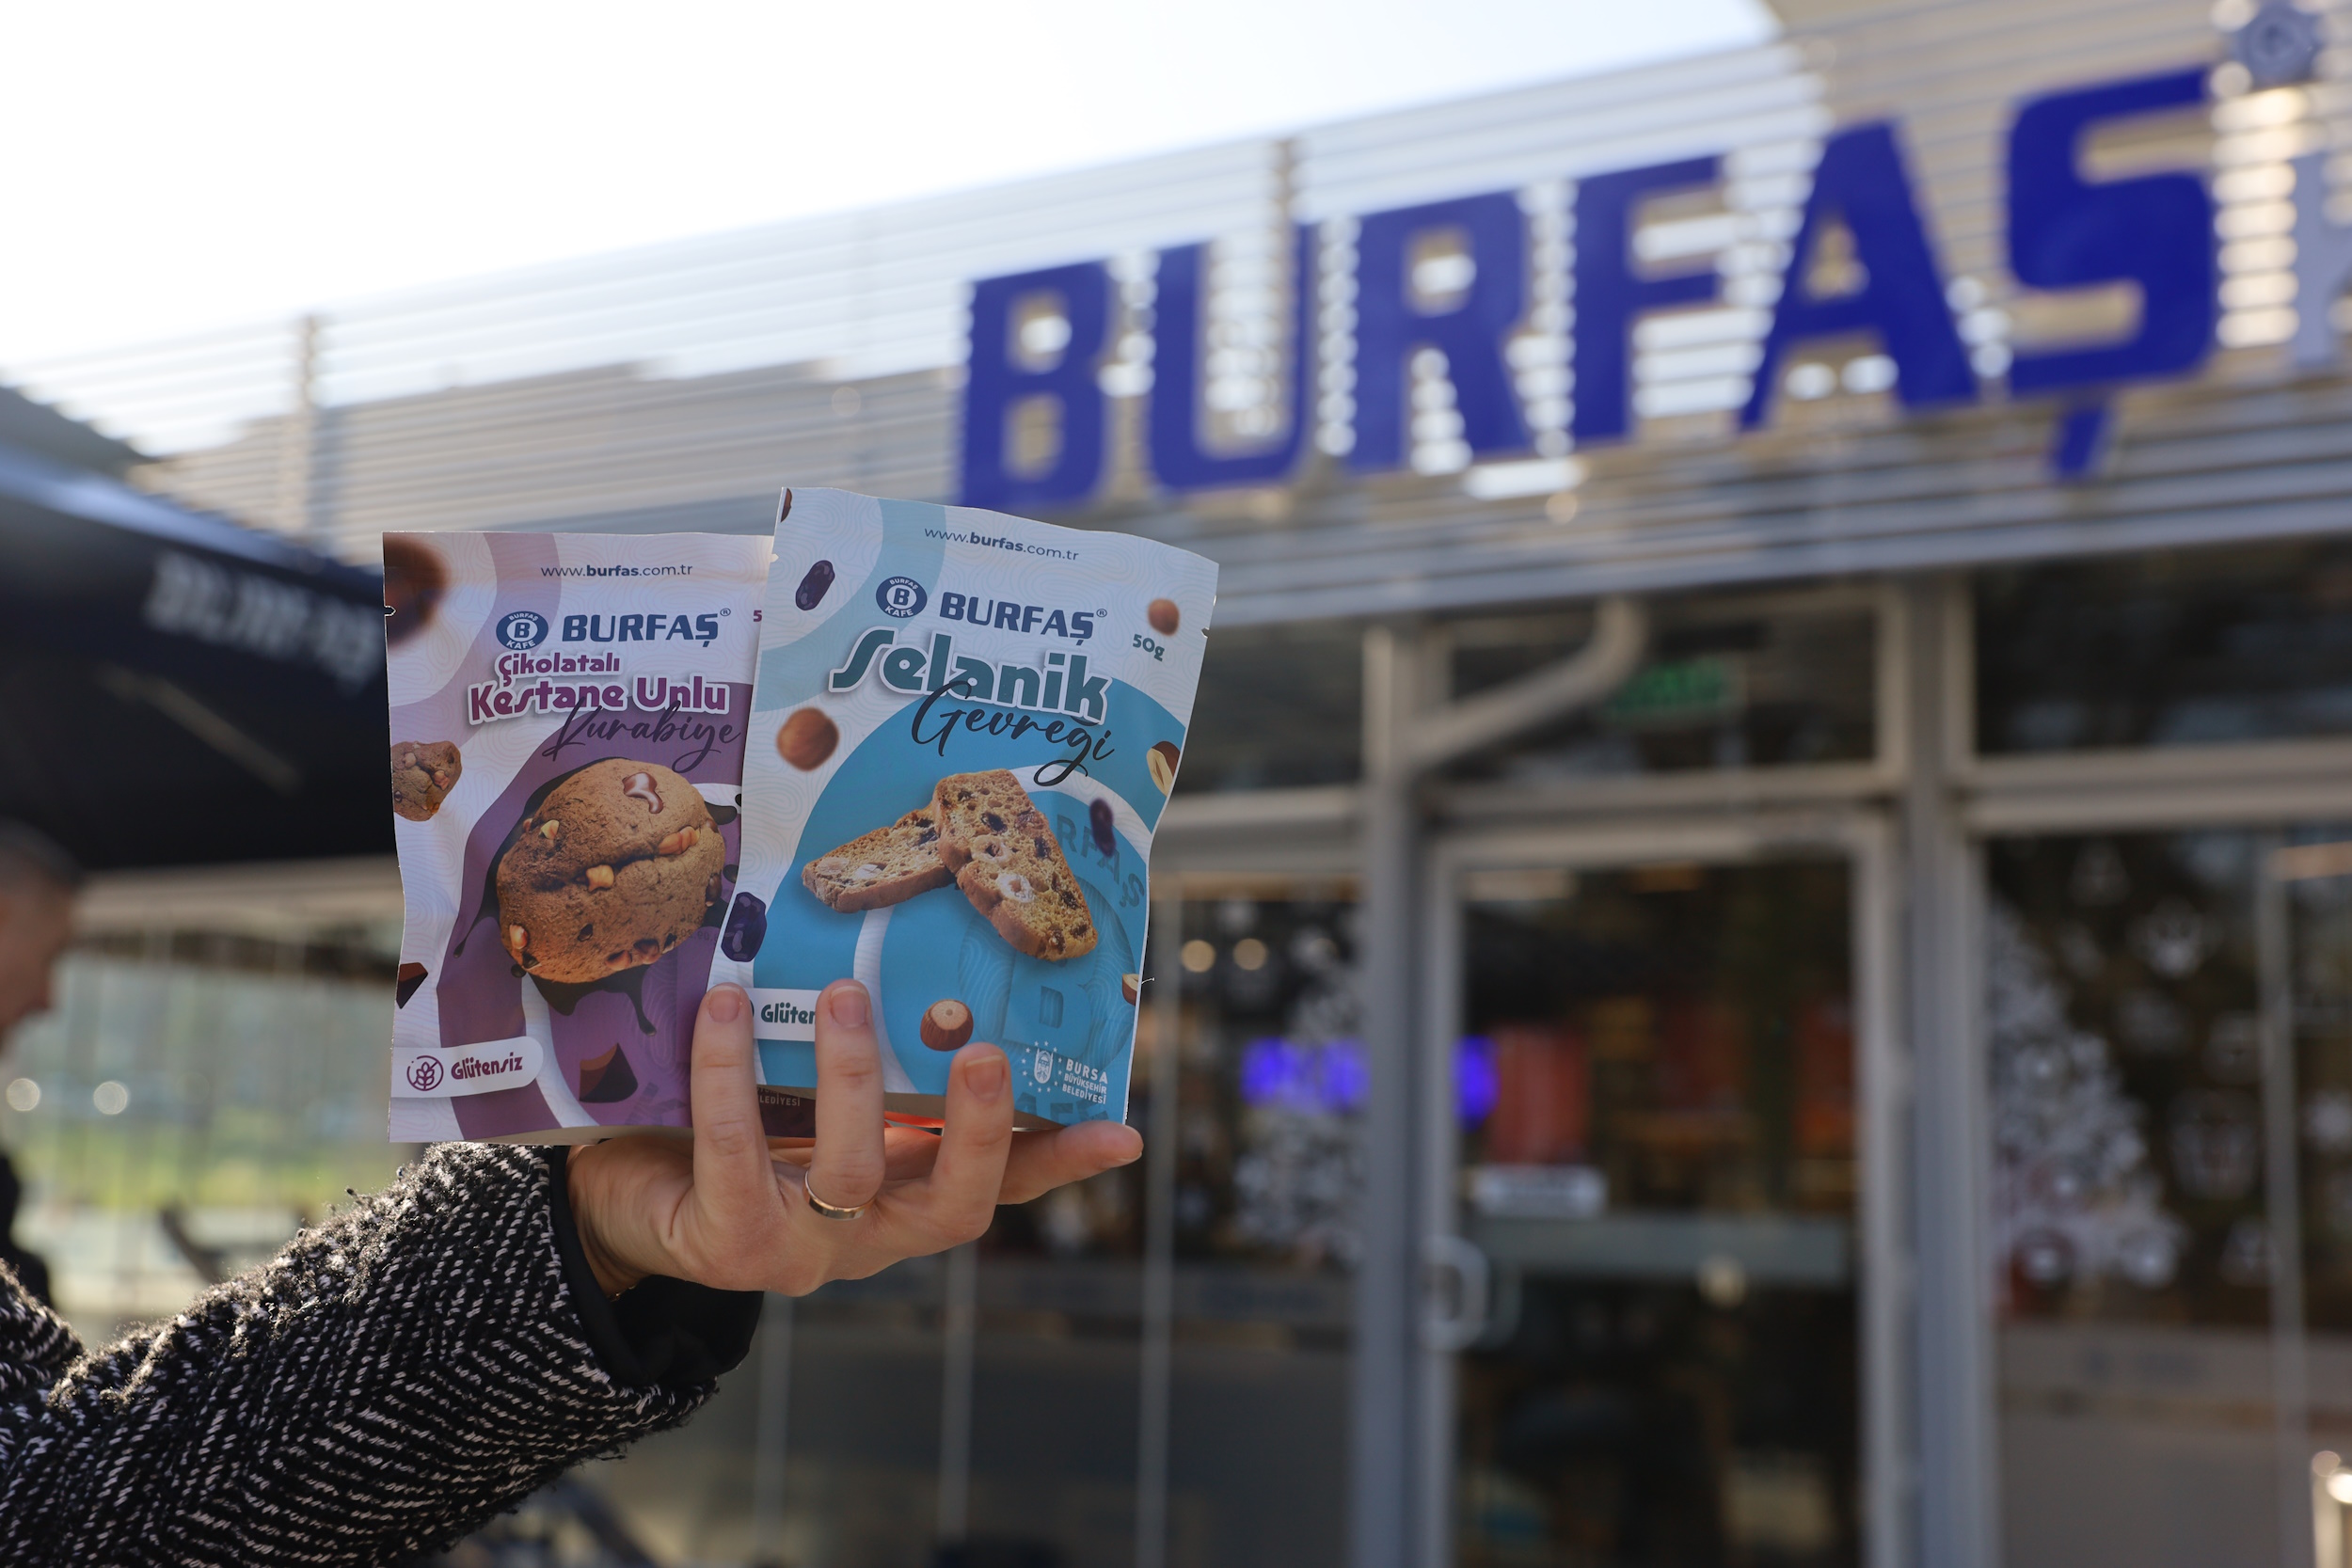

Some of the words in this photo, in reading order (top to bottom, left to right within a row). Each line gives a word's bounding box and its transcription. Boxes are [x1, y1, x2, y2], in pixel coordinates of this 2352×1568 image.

[954, 62, 2218, 510] BURFAŞ
[924, 528, 1079, 560] www.burfas.com.tr
[541, 564, 693, 578] www.burfas.com.tr
[889, 578, 919, 590] BURFAŞ
[893, 587, 910, 606] B
[508, 612, 539, 621] BURFAŞ
[884, 605, 914, 617] KAFE
[939, 592, 1095, 646] BURFAŞ
[514, 622, 531, 639] B
[562, 612, 719, 648] BURFAŞ
[506, 640, 535, 649] KAFE
[1132, 633, 1165, 662] 50g
[498, 651, 621, 688] Çikolatalı
[833, 629, 1110, 721] Selanik
[470, 680, 625, 721] Kestane
[636, 675, 726, 711] Unlu
[542, 696, 741, 773] Kurabiye
[451, 1052, 523, 1080] Glütensiz
[1065, 1058, 1108, 1085] BURSA
[1062, 1083, 1107, 1104] BELEDİYESİ
[1064, 1073, 1107, 1095] BÜYÜKŞEHİR
[759, 1092, 801, 1107] LEDİYESİ
